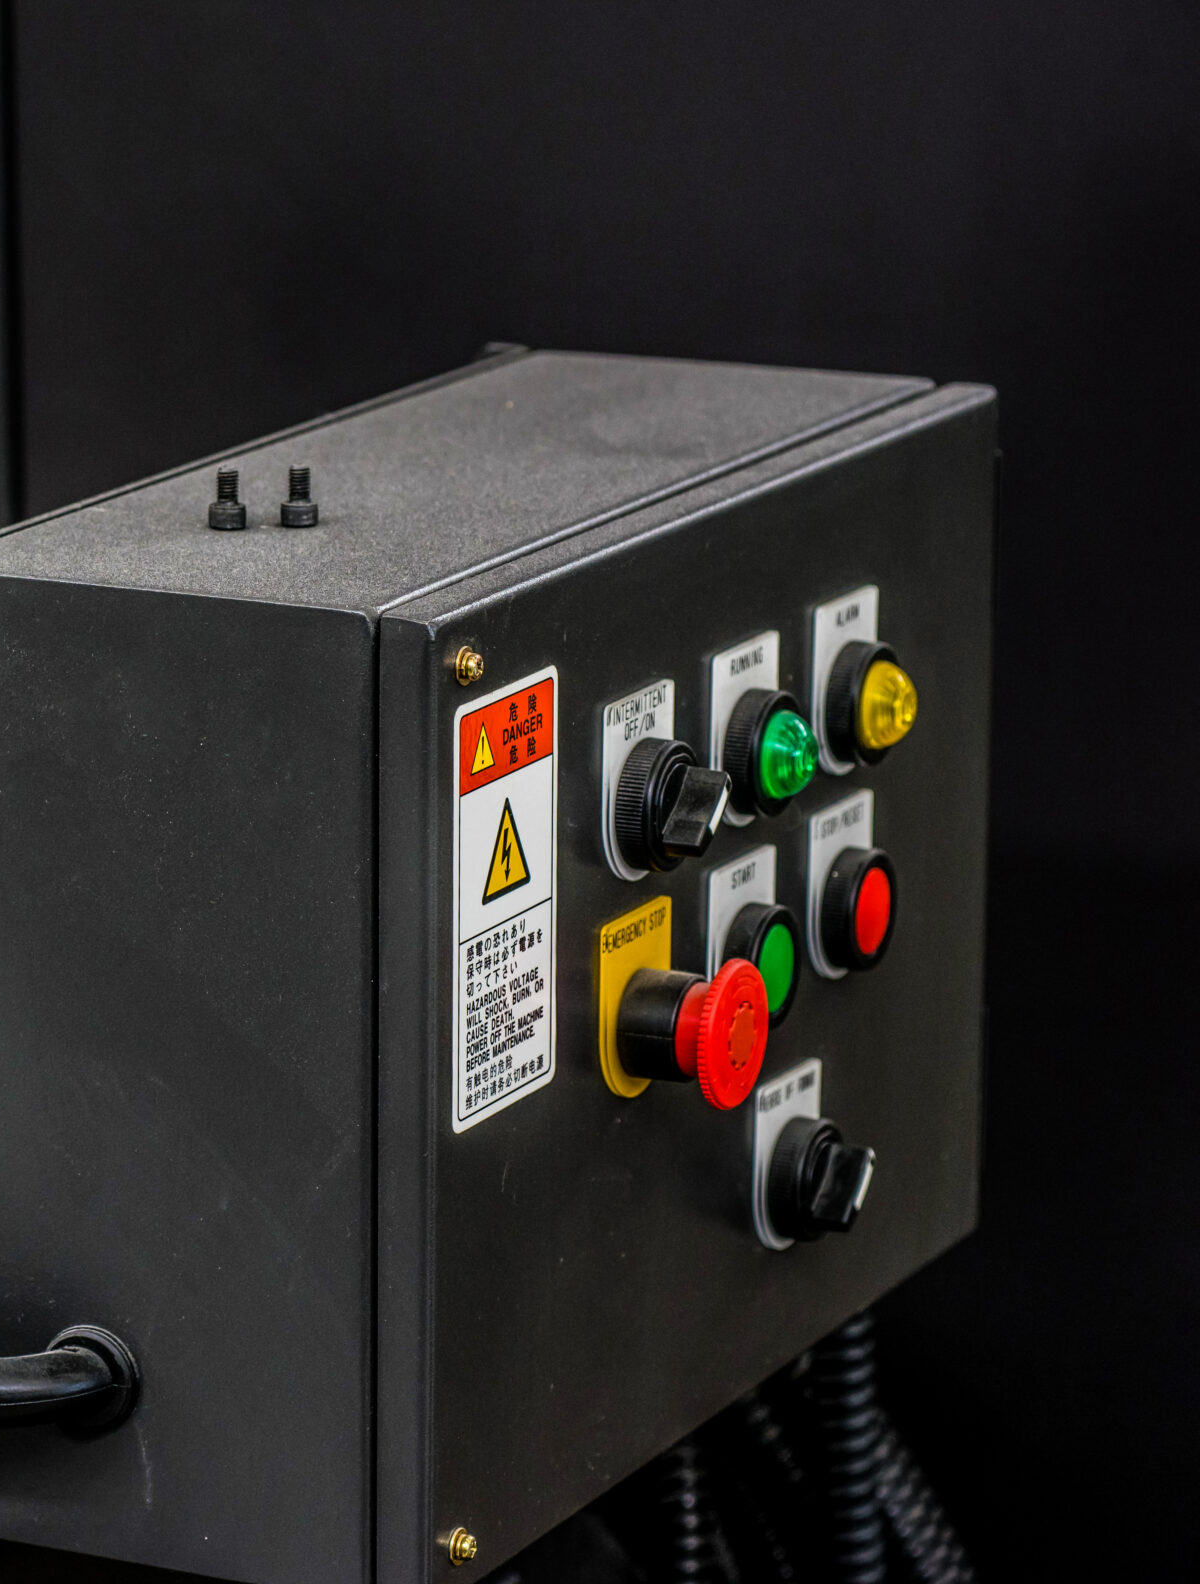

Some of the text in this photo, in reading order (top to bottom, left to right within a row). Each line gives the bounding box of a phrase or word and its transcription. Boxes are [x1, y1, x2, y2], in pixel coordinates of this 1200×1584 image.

[835, 603, 860, 628] ALARM
[730, 646, 764, 677] RUNNING
[508, 694, 538, 723] 危険
[612, 684, 667, 727] INTERMITTENT
[502, 713, 543, 745] DANGER
[731, 861, 757, 891] START
[466, 918, 526, 963] 感電の恐れあり
[606, 906, 666, 953] EMERGENCY STOP
[466, 928, 543, 981] 保守時は必ず電源を
[466, 962, 518, 998] 切って下さい
[466, 967, 539, 1015] HAZARDOUS VOLTAGE
[466, 1011, 483, 1030] WILL
[534, 980, 544, 995] OR
[466, 1010, 515, 1044] CAUSE DEATH.
[466, 1006, 544, 1058] POWER OFF THE MACHINE
[466, 1028, 536, 1072] BEFORE MAINTENANCE.
[465, 1056, 513, 1092] 有触电的危险
[465, 1054, 544, 1110] 维护时请务必切断电源
